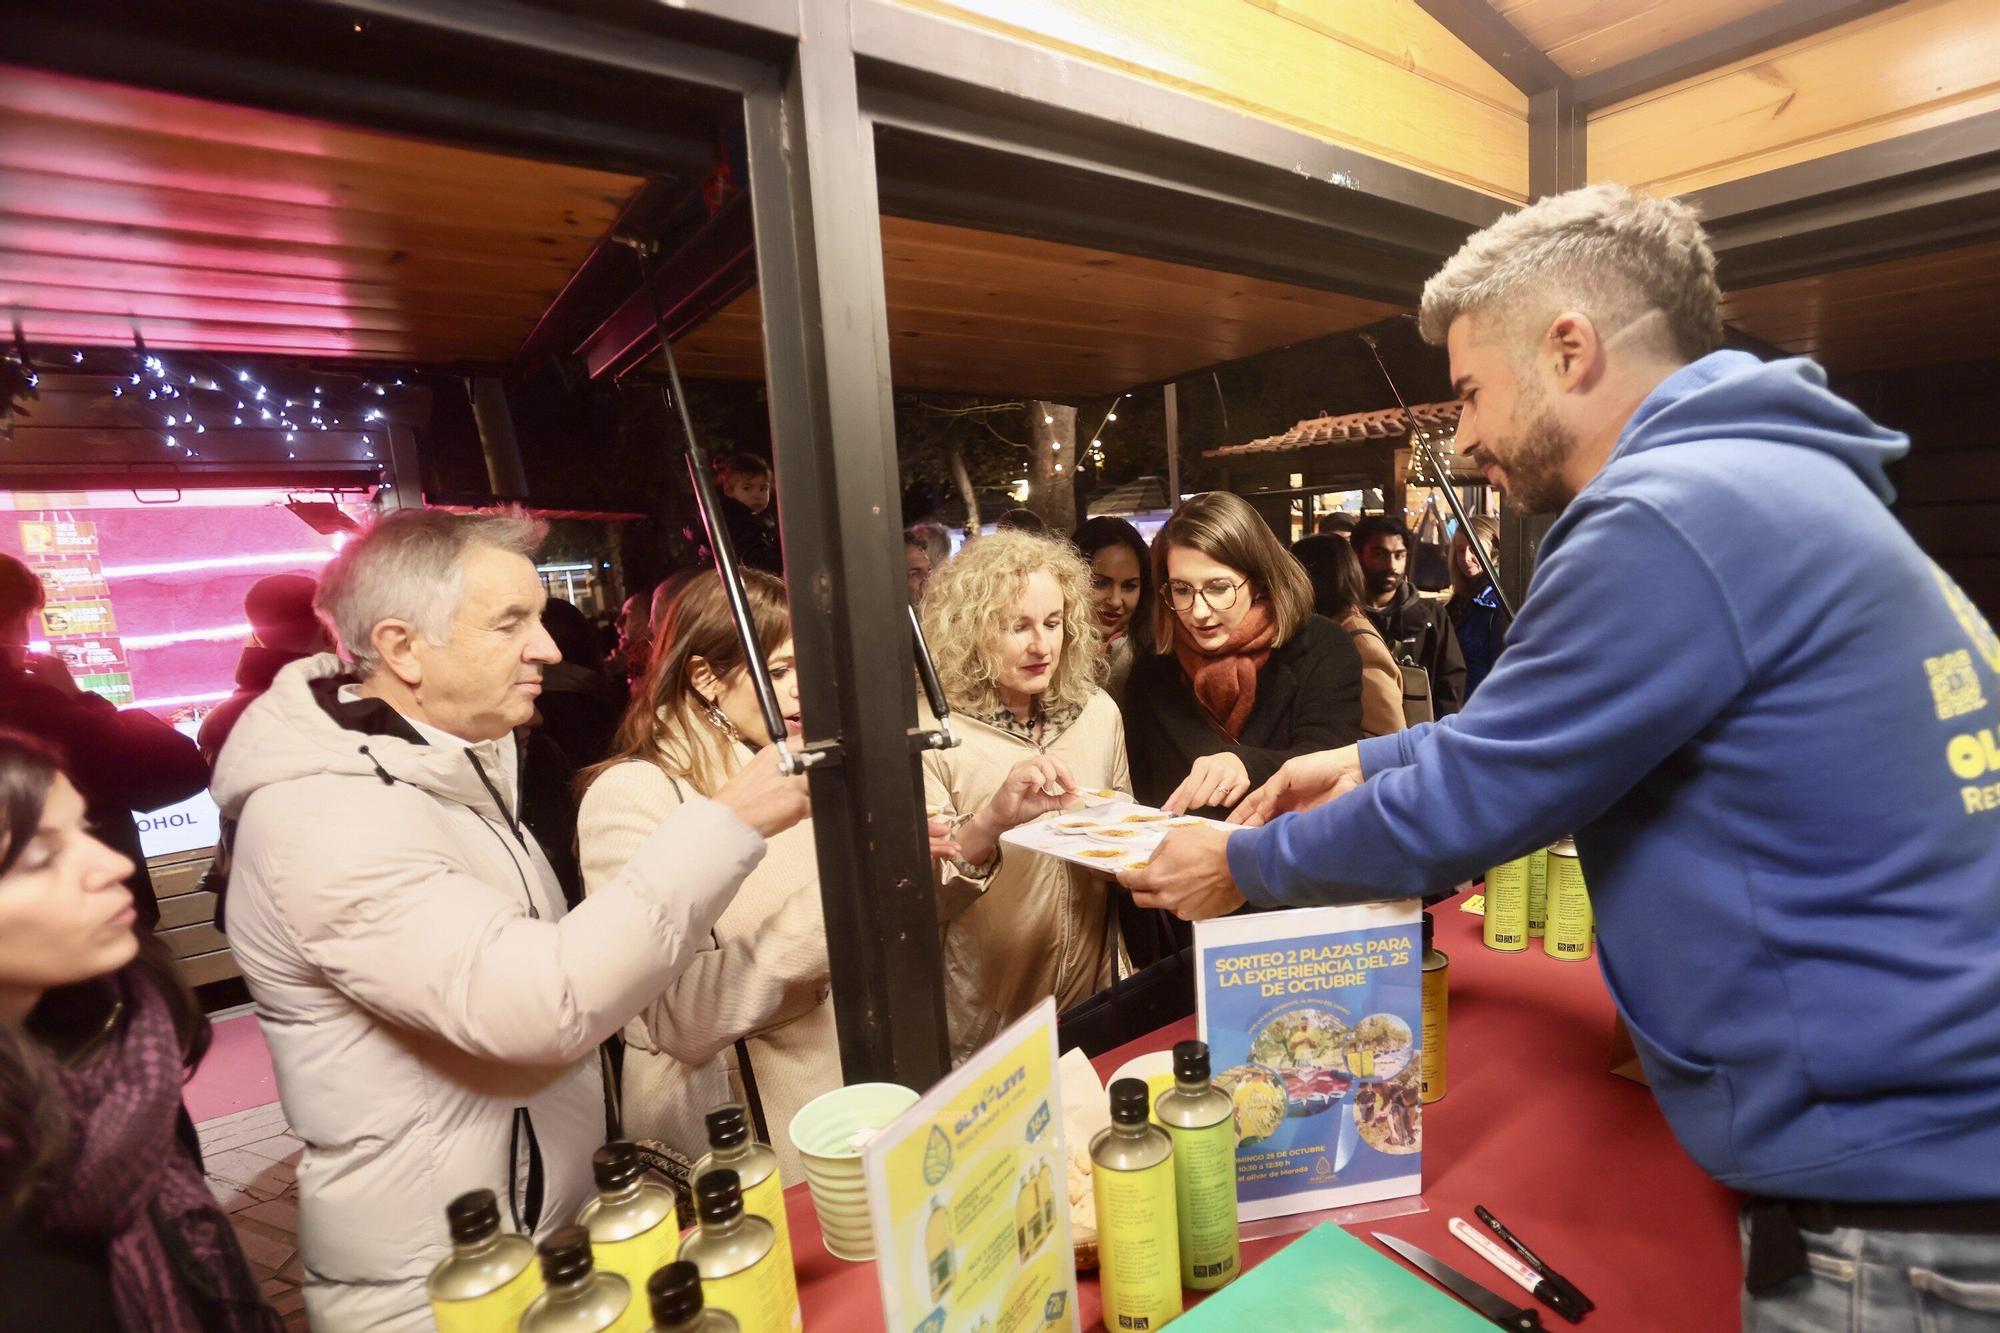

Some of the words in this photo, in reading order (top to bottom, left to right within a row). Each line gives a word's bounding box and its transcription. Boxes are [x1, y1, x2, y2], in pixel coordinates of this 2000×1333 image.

[1946, 729, 2000, 779] OL
[136, 812, 198, 833] OHOL
[1215, 951, 1285, 973] SORTEO
[1287, 949, 1297, 965] 2
[1300, 943, 1365, 963] PLAZAS
[1366, 937, 1412, 954] PARA
[1219, 972, 1242, 988] LA
[1245, 959, 1353, 985] EXPERIENCIA
[1356, 954, 1389, 970] DEL
[1390, 951, 1409, 967] 25
[1261, 981, 1285, 998] DE
[1287, 972, 1367, 994] OCTUBRE
[1289, 1145, 1327, 1157] OCTUBRE
